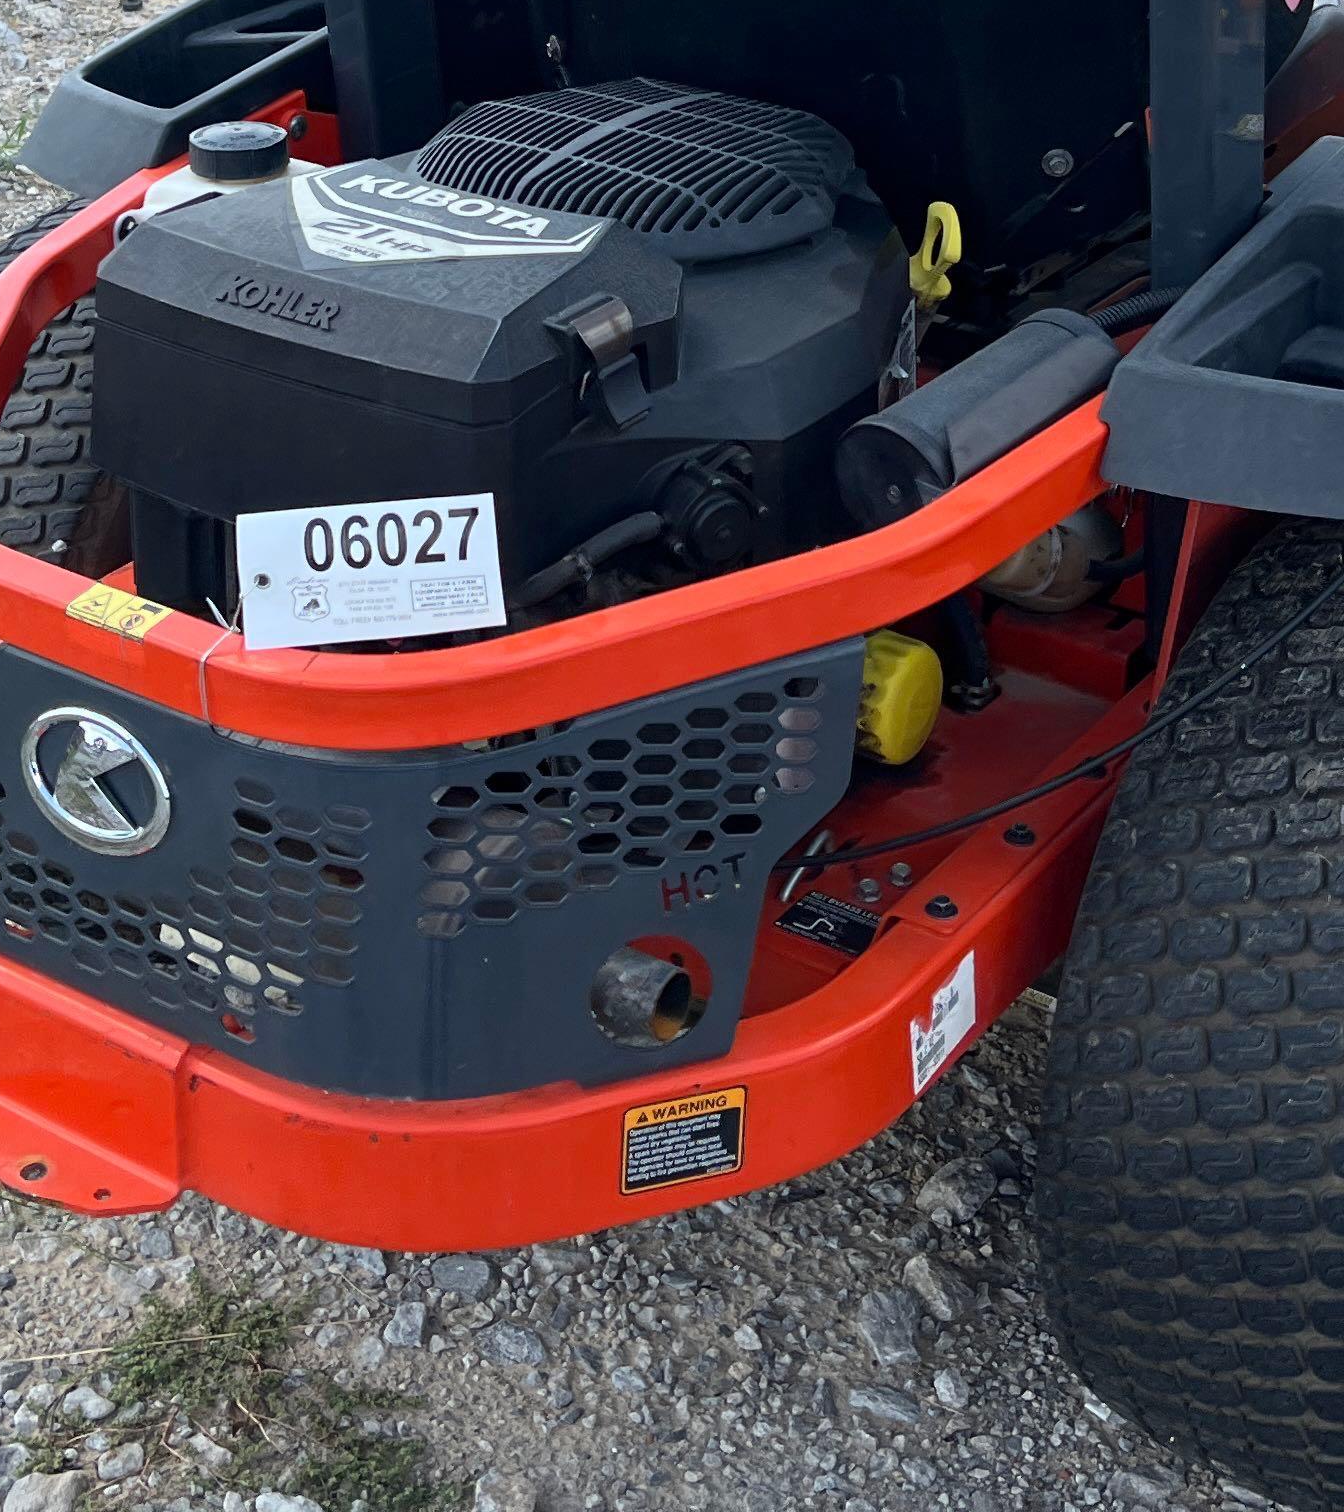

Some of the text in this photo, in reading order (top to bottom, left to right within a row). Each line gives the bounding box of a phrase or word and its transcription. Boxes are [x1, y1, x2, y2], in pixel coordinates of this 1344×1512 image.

[340, 175, 551, 238] KUBOTA
[216, 276, 341, 332] KOHLER
[304, 507, 479, 572] 06027
[653, 1095, 727, 1120] WARNING
